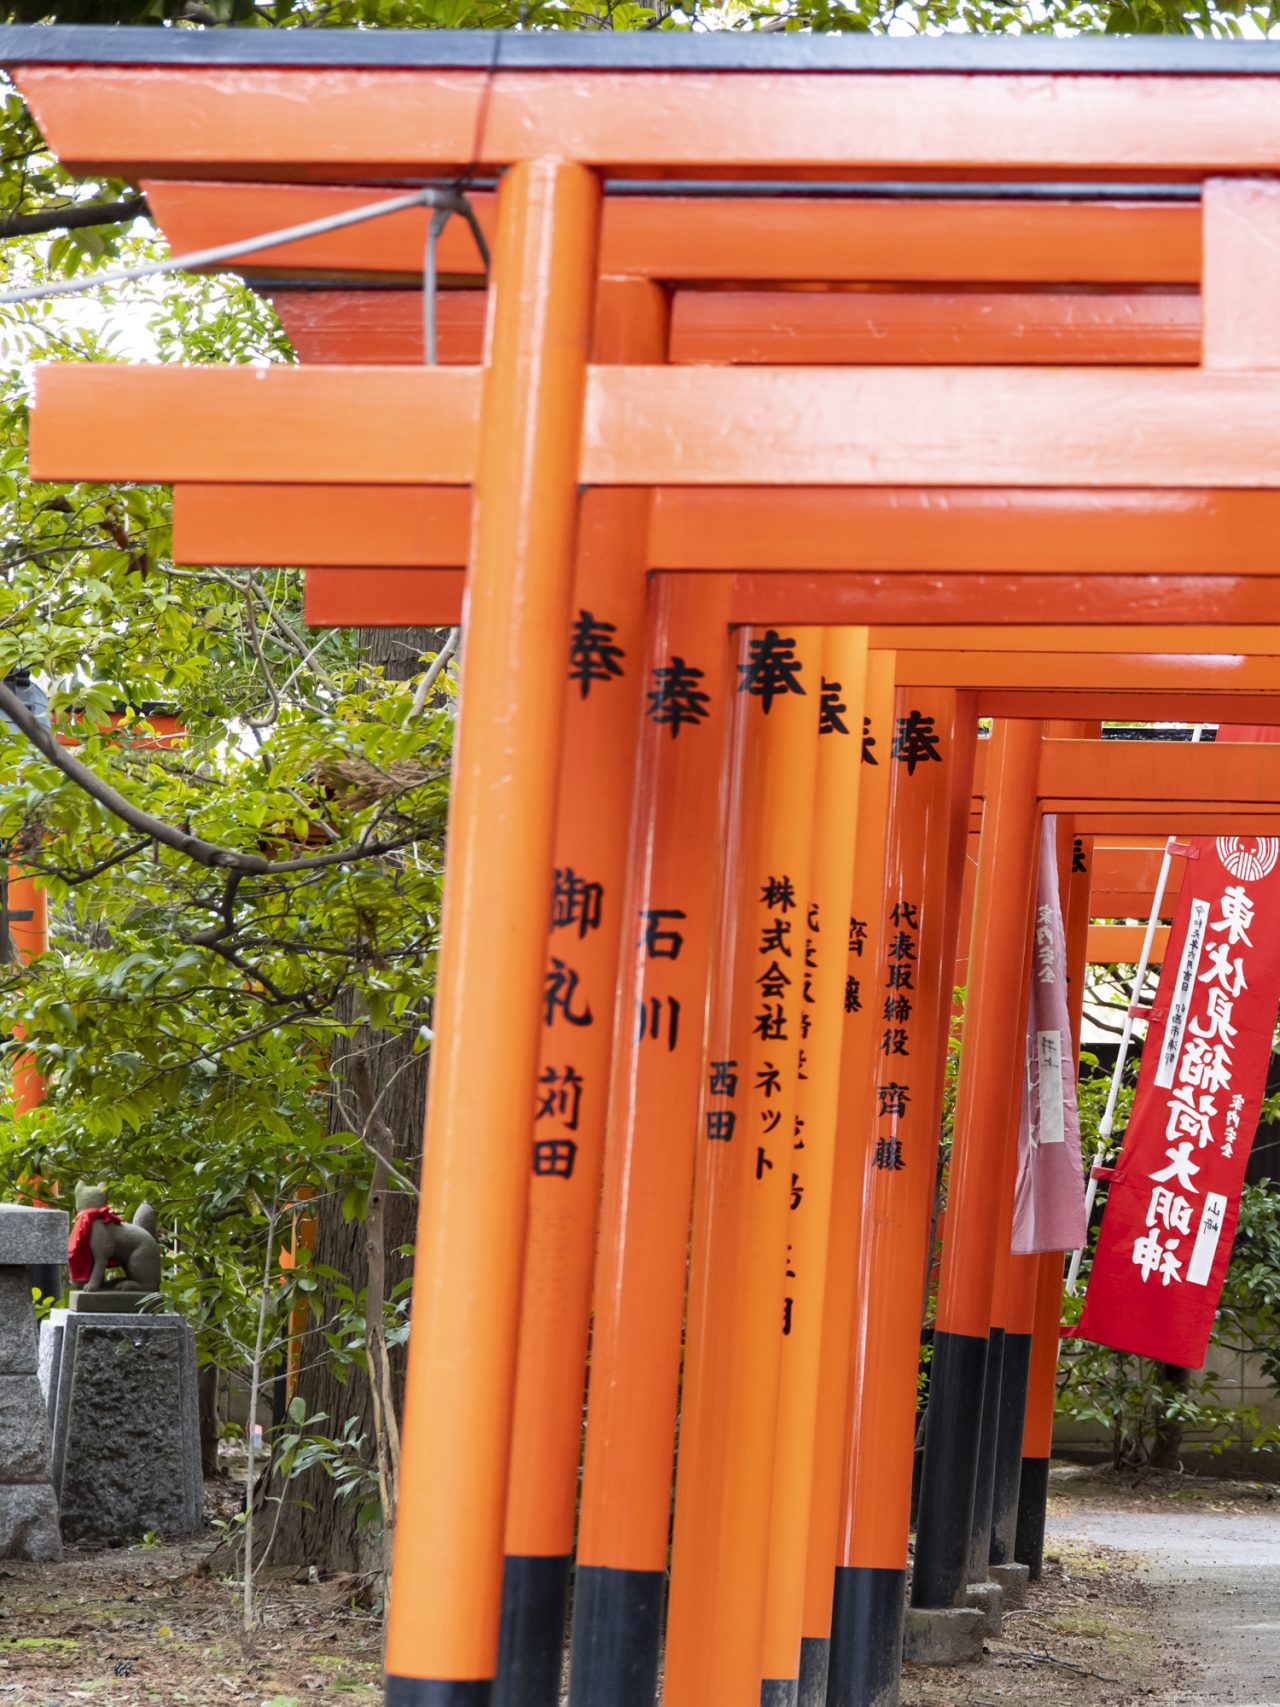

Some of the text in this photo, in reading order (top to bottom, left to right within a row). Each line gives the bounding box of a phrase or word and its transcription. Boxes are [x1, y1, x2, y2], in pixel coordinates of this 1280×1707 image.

[569, 610, 625, 699] 奉
[647, 657, 710, 739] 奉
[736, 630, 806, 715] 奉
[891, 710, 942, 776] 奉
[633, 909, 687, 1052] 石川
[752, 875, 796, 1041] 株式会社
[879, 901, 918, 1057] 代表取締役
[706, 1061, 738, 1142] 西田
